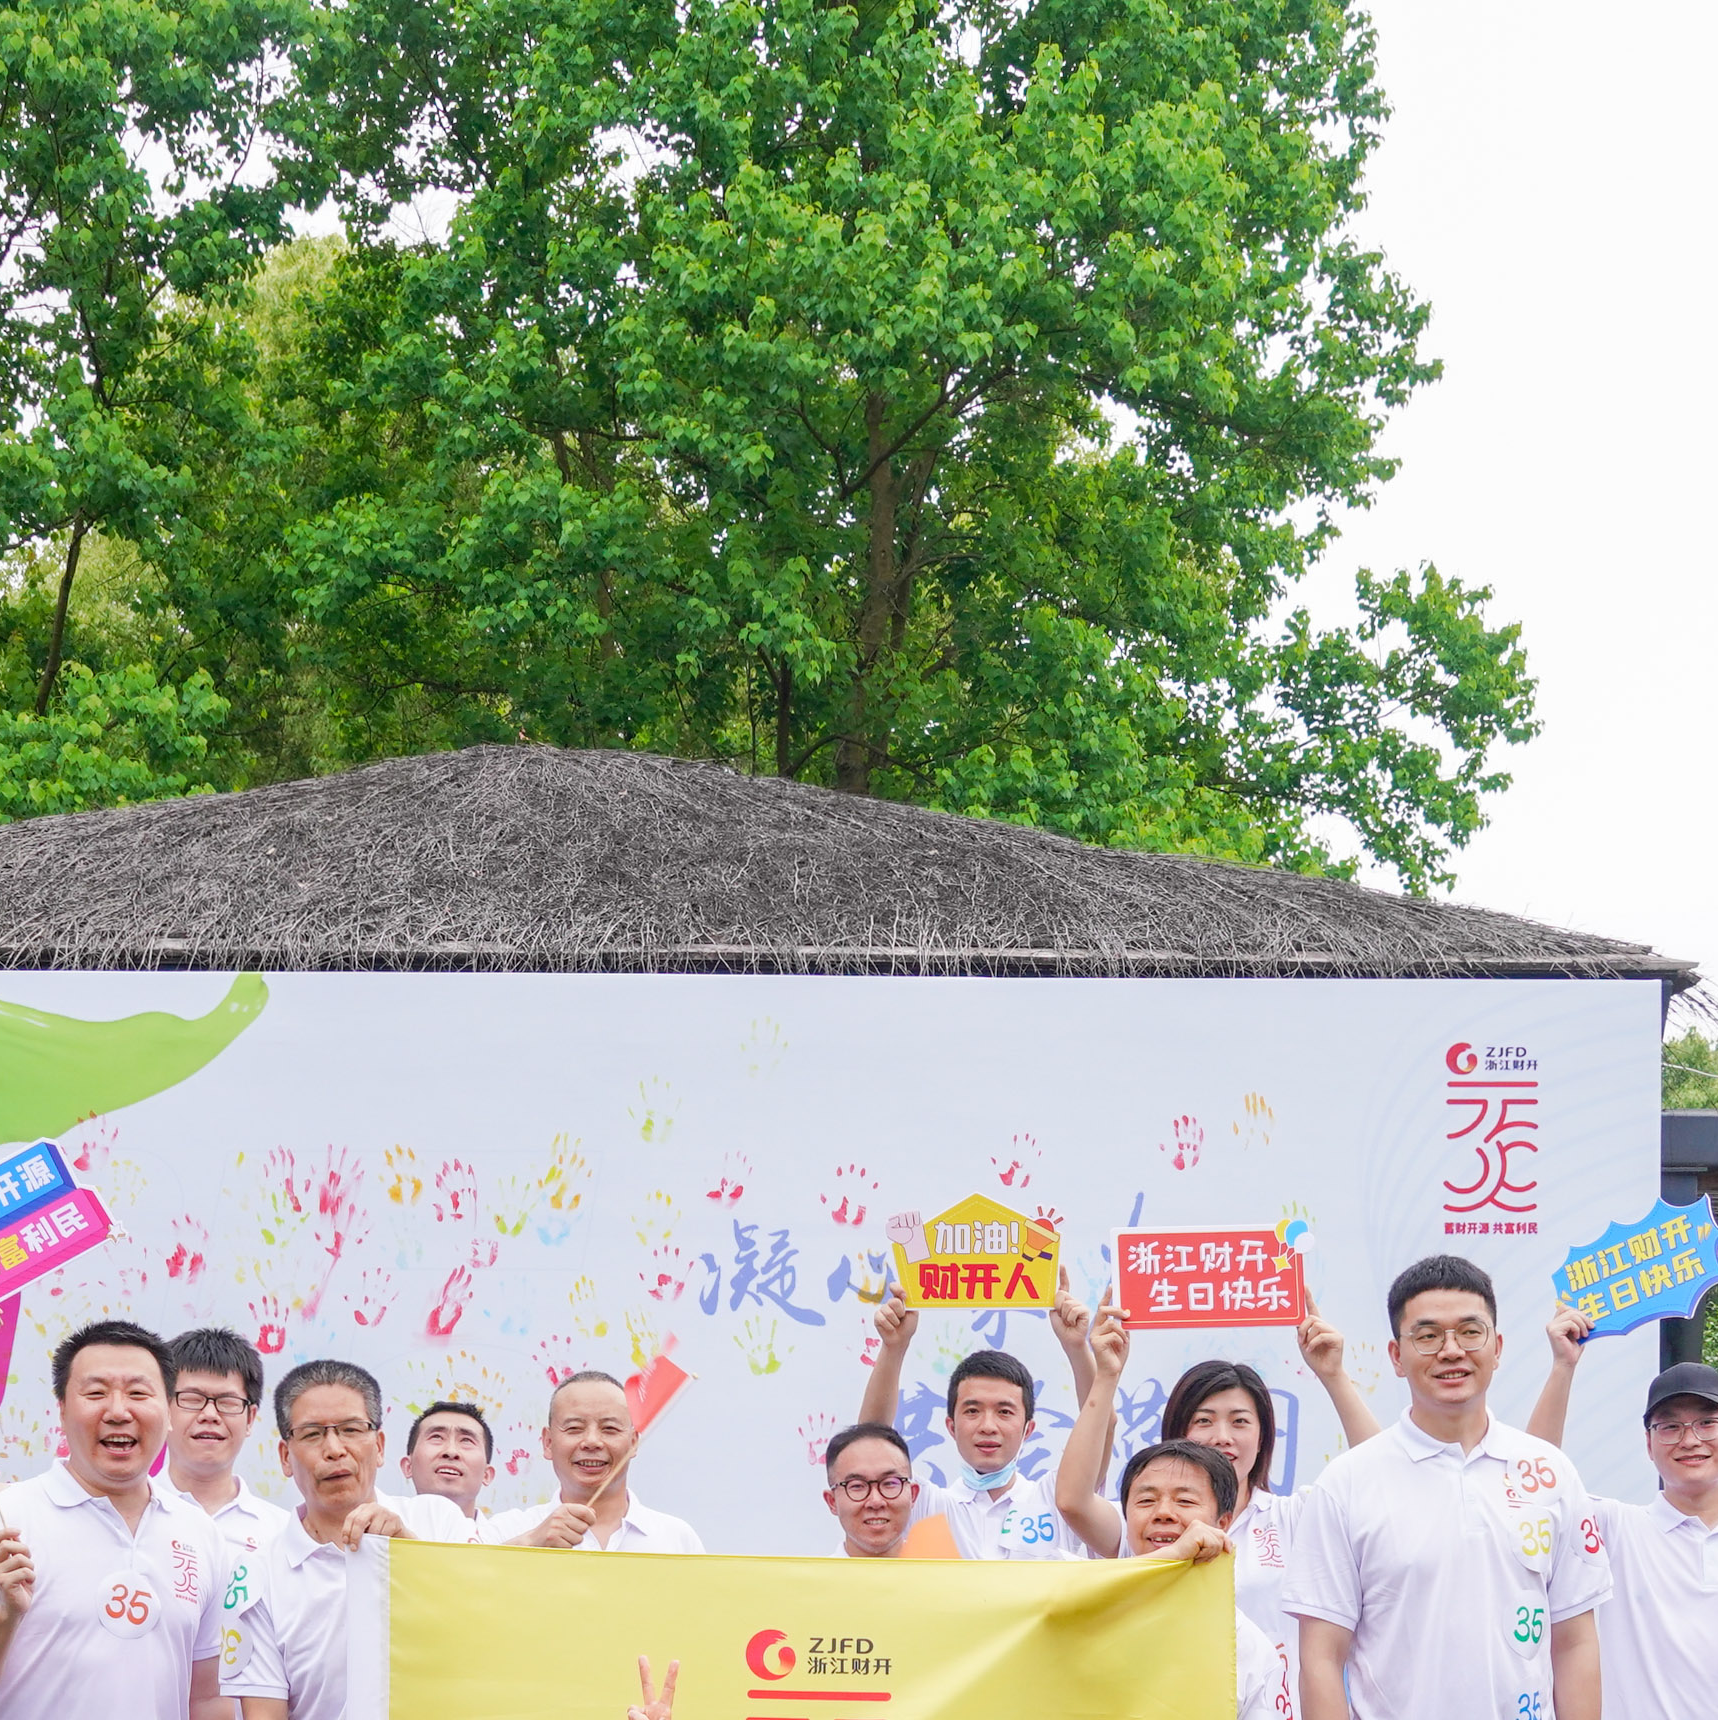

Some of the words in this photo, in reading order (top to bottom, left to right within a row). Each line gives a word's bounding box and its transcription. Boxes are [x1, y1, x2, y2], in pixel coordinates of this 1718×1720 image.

[1484, 1059, 1539, 1071] 浙江财开
[1485, 1046, 1527, 1058] ZJFD
[933, 1220, 1021, 1256] 加油!
[1443, 1221, 1491, 1235] 蓄财开源
[1492, 1221, 1539, 1235] 共富利民
[1126, 1238, 1275, 1275] 浙江财开
[1564, 1213, 1693, 1293] 浙江财开
[918, 1262, 1040, 1300] 财开人
[1147, 1275, 1292, 1313] 生日快乐
[1576, 1247, 1707, 1323] 生日快乐
[1517, 1456, 1557, 1493] 35
[1020, 1512, 1054, 1544] 35
[1519, 1518, 1551, 1557] 35
[105, 1583, 152, 1625] 35
[1513, 1606, 1545, 1644] 35
[808, 1637, 874, 1654] ZJFD
[807, 1656, 892, 1675] 浙江财开
